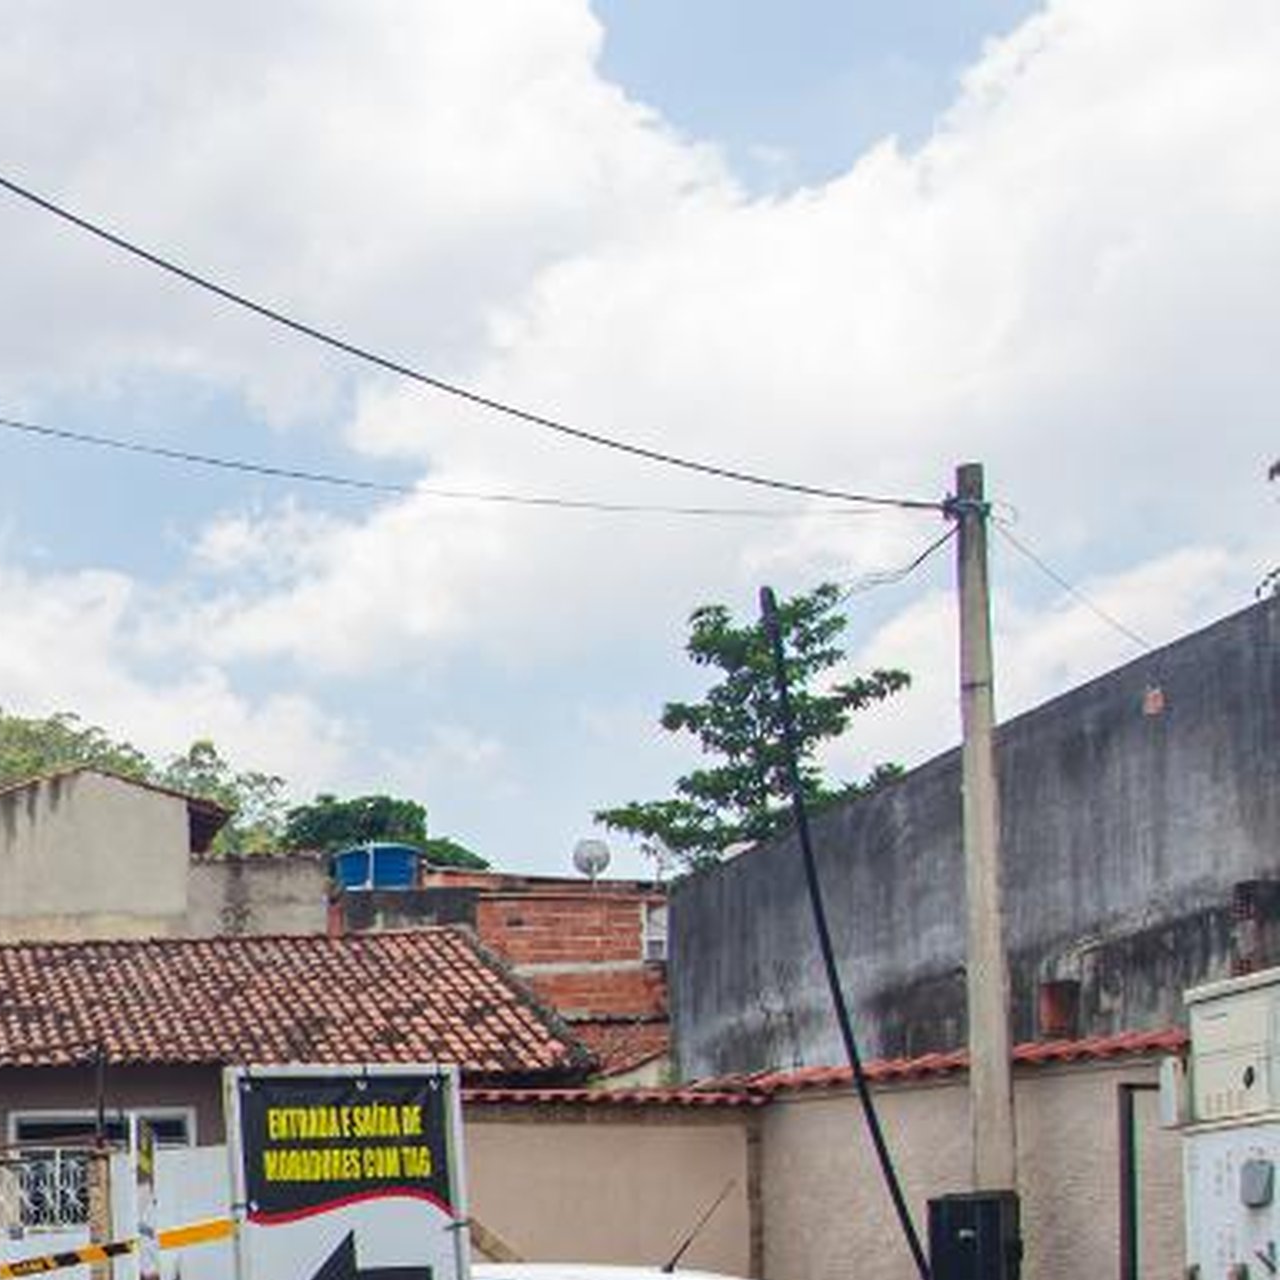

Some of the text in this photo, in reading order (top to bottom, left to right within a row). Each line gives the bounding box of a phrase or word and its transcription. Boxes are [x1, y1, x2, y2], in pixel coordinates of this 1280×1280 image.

[267, 1106, 341, 1140] ENTRADA
[342, 1106, 351, 1137] E
[402, 1105, 424, 1135] DE
[264, 1148, 361, 1181] MORADORES
[363, 1147, 401, 1178] COM
